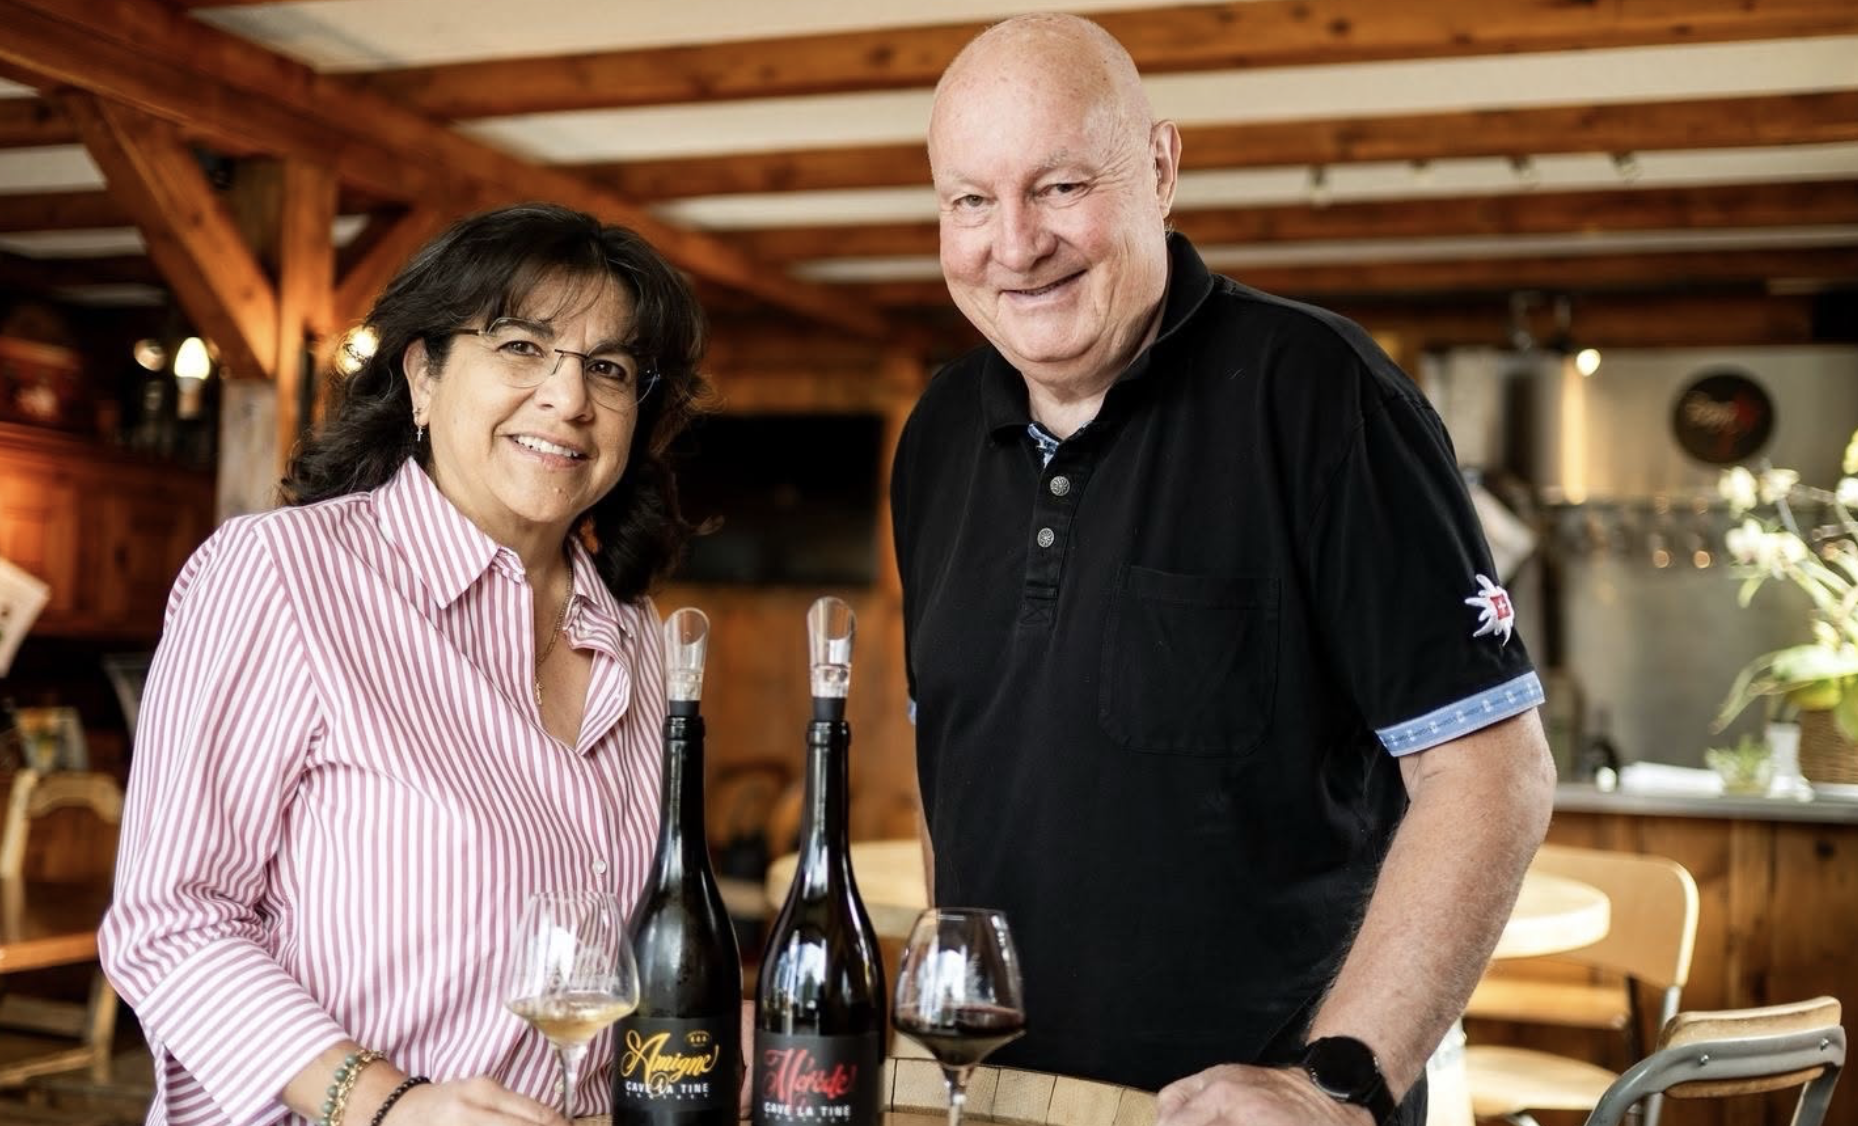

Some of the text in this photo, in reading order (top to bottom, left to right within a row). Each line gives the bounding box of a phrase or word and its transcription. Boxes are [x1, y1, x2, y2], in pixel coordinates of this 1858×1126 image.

[620, 1029, 720, 1089] Amigne
[625, 1080, 709, 1095] CAVE LA TINE
[763, 1101, 850, 1118] CAVE LA TINE
